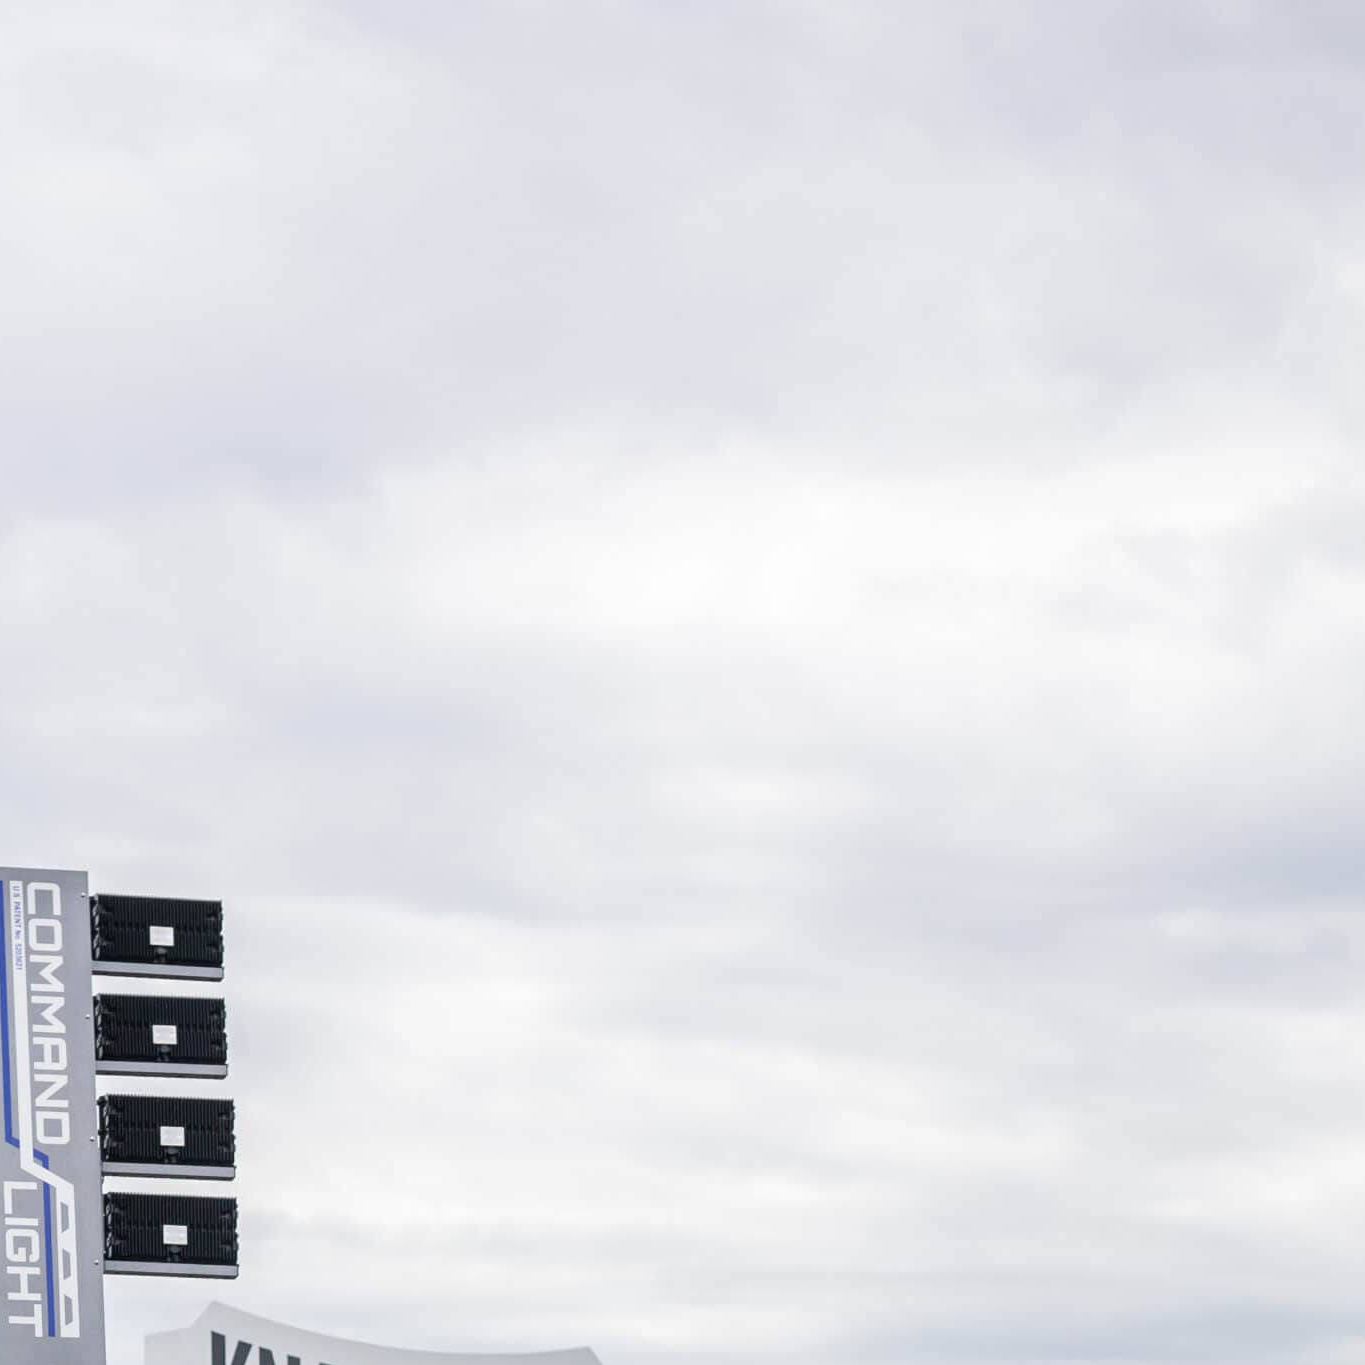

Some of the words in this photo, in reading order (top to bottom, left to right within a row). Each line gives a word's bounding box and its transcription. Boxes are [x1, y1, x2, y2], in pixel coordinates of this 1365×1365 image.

[13, 901, 22, 928] PATENT
[26, 881, 71, 1145] COMMAND
[2, 1180, 43, 1338] LIGHT
